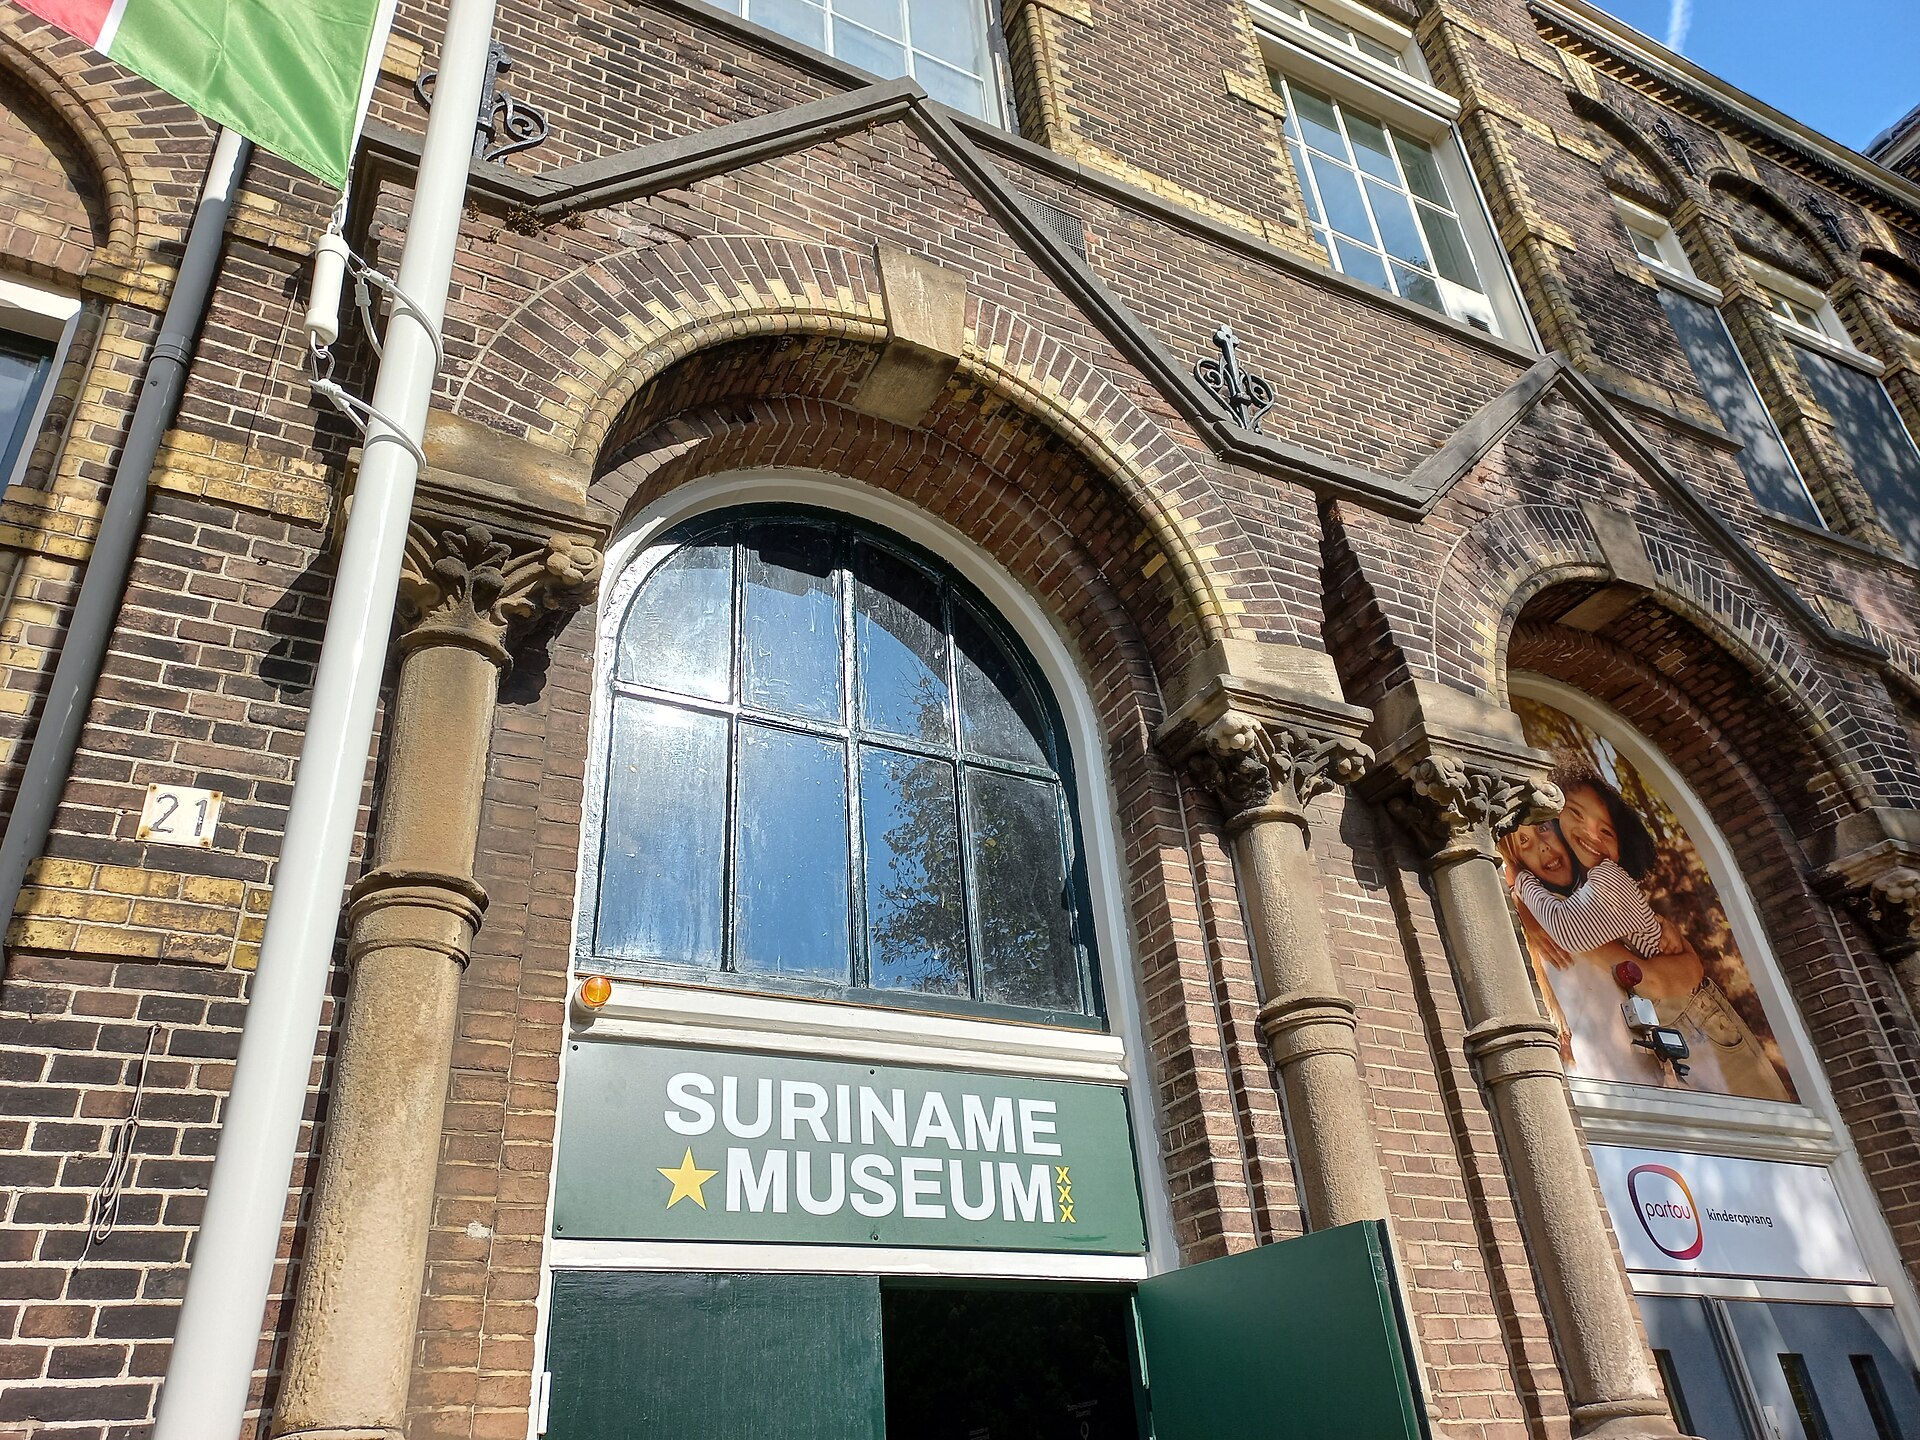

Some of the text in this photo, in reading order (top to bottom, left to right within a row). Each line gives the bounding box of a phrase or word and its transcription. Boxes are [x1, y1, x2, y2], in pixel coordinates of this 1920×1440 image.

[150, 794, 208, 837] 21
[663, 1072, 1063, 1157] SURINAME
[725, 1147, 1056, 1223] MUSEUM
[1645, 1200, 1691, 1221] partou
[1706, 1208, 1774, 1228] kinderopvang
